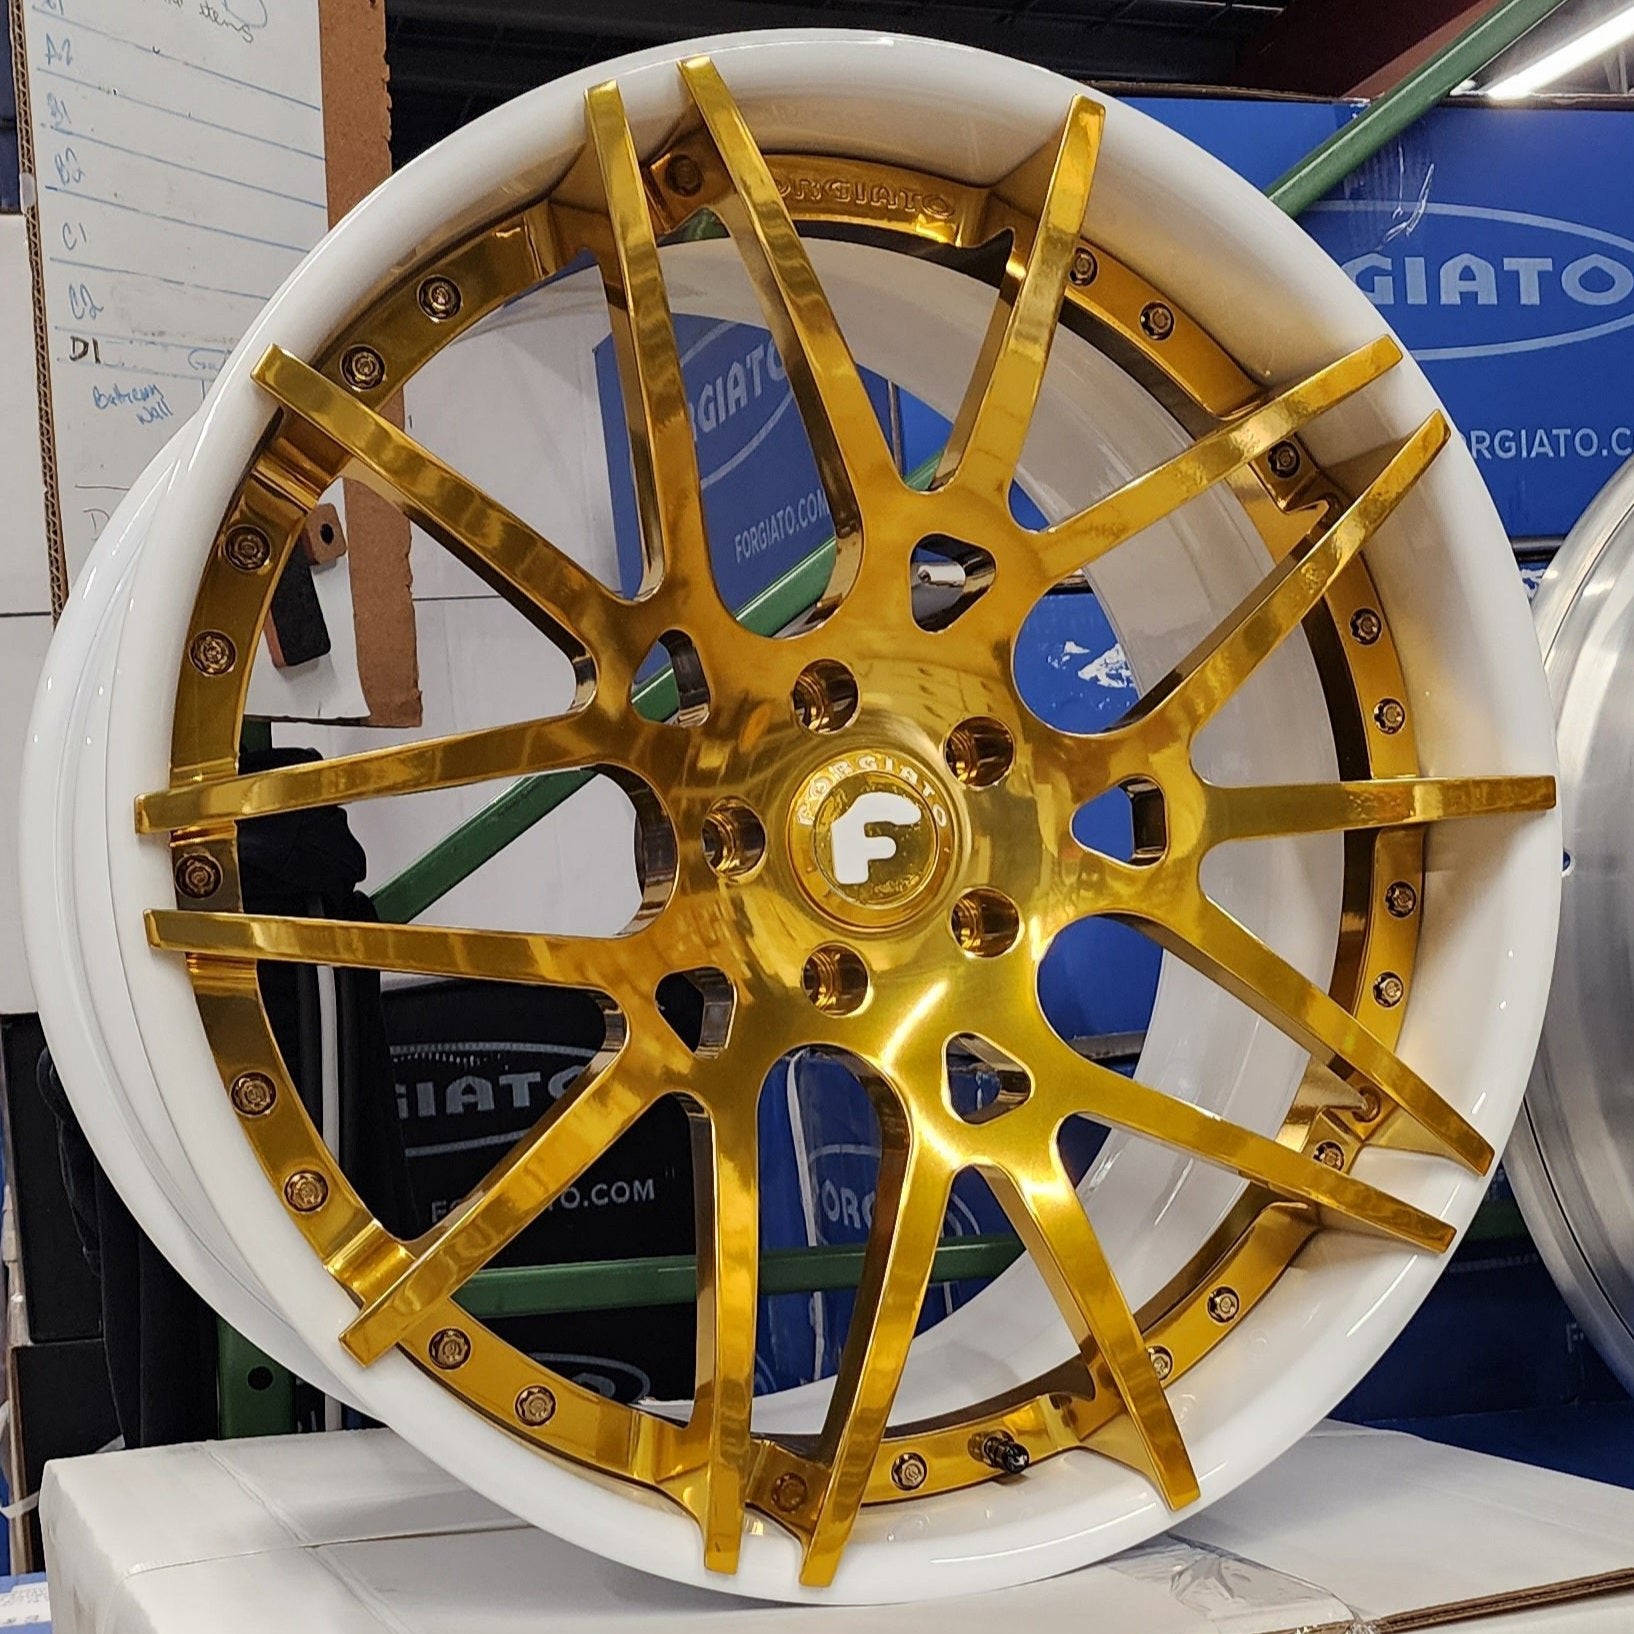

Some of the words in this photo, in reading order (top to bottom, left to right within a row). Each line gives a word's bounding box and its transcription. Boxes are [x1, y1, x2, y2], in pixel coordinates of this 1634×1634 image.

[55, 148, 85, 184] B2
[62, 220, 87, 250] C1
[68, 284, 104, 320] C2
[69, 336, 101, 364] D1
[1461, 427, 1634, 460] RGIATO.C
[797, 755, 947, 827] FORGIATO
